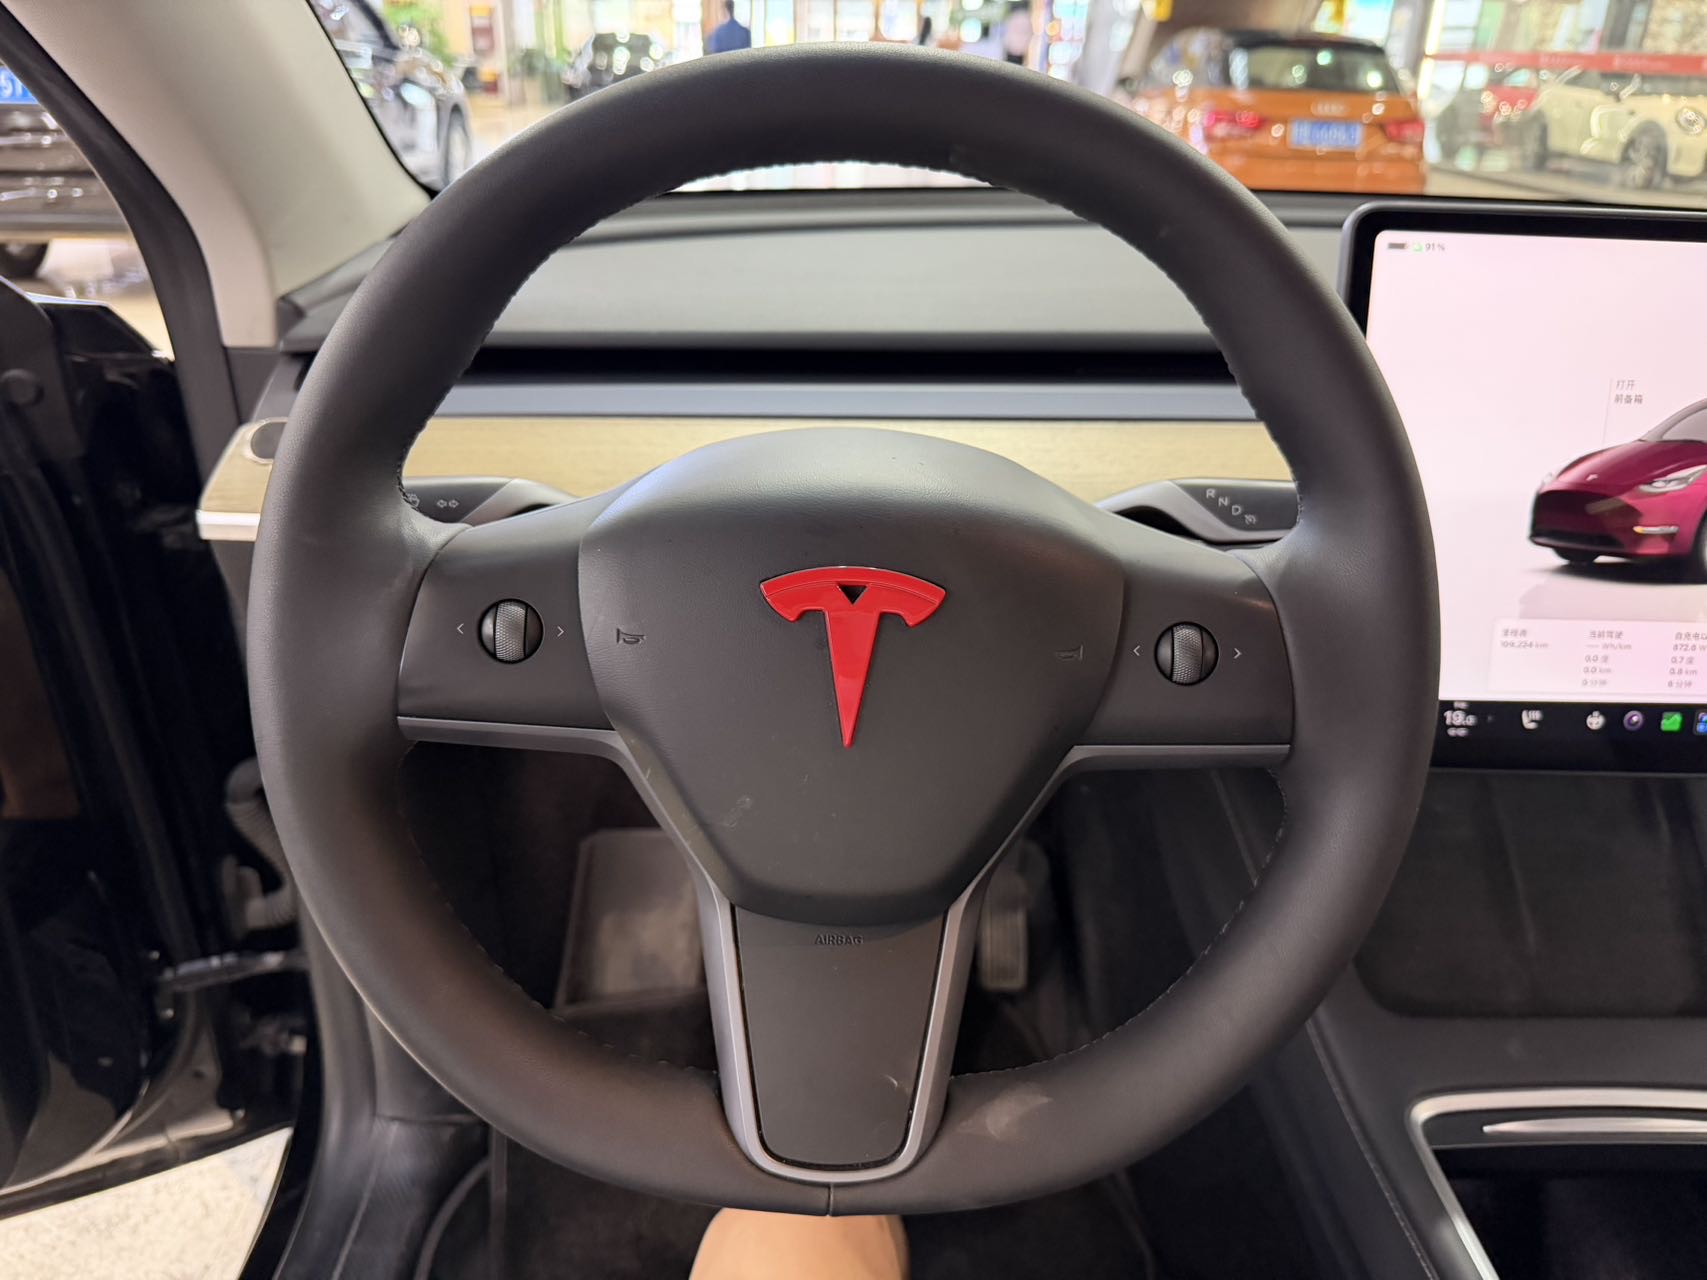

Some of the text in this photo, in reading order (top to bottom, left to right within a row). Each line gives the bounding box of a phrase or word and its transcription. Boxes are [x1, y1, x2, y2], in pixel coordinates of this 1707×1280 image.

[1206, 489, 1241, 516] R N D
[815, 934, 863, 945] AIRBAG
